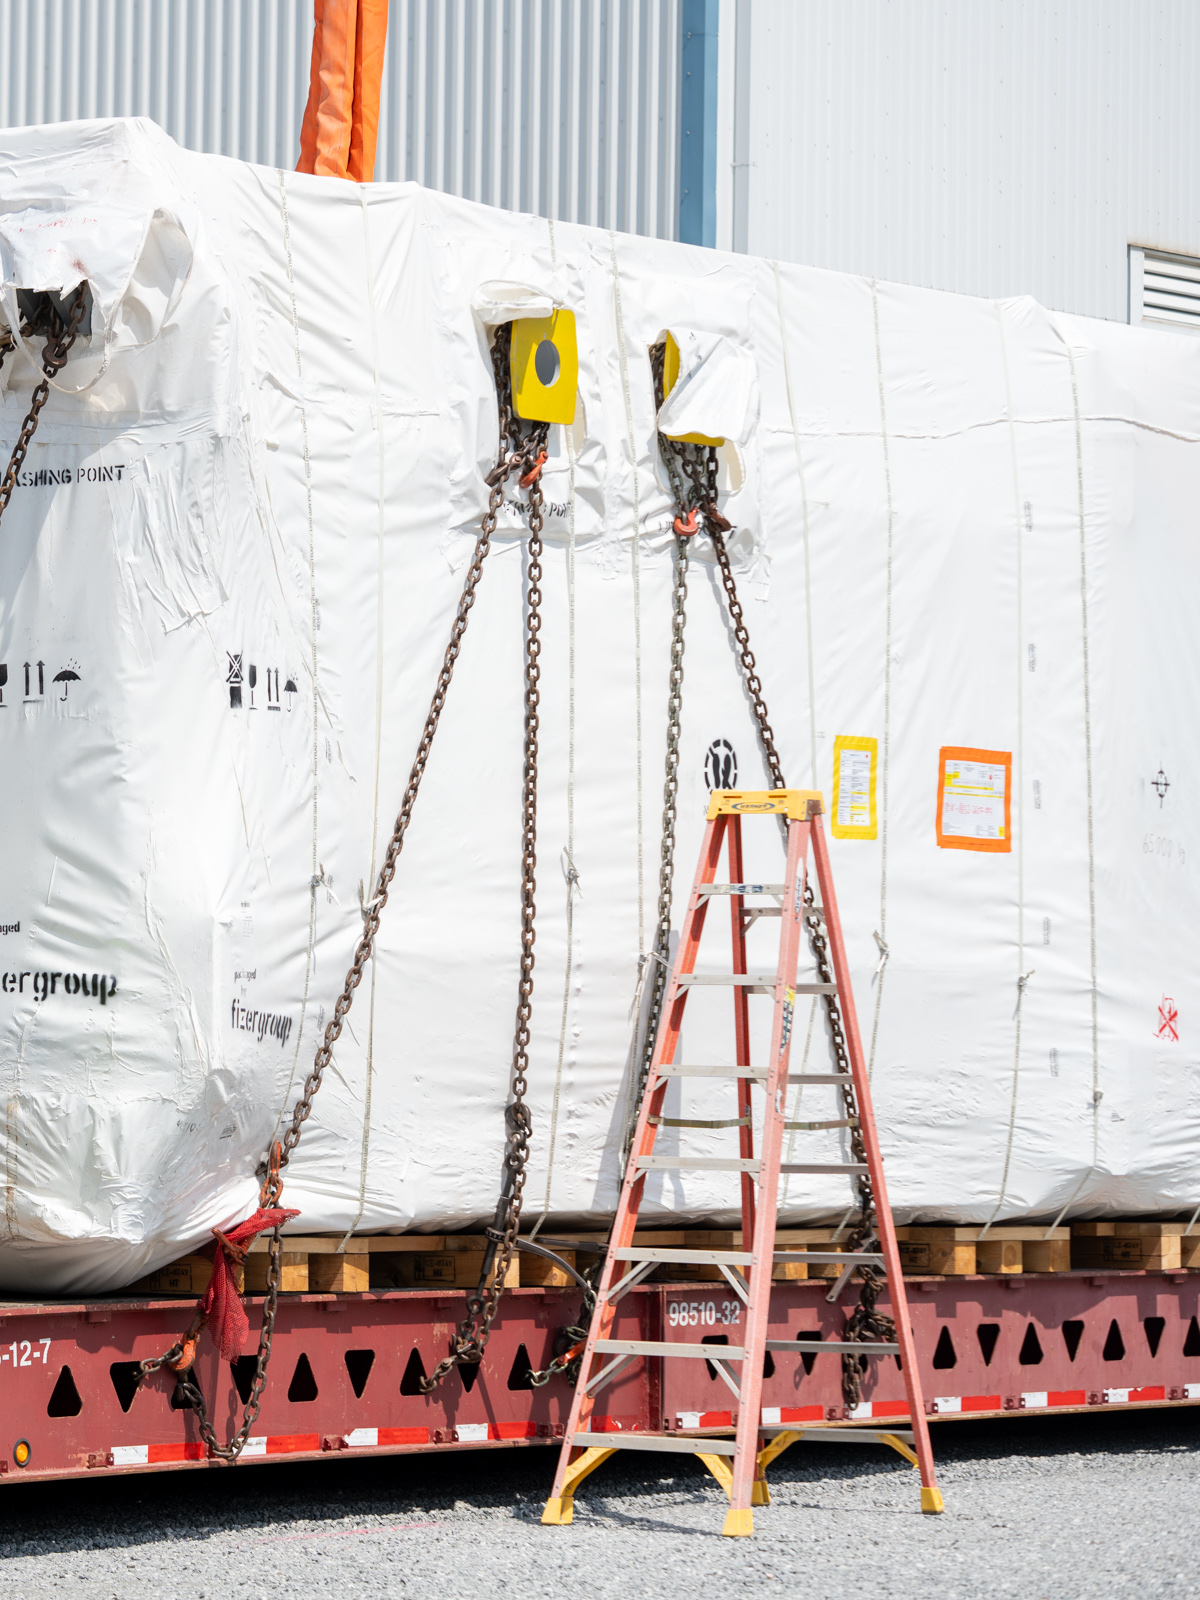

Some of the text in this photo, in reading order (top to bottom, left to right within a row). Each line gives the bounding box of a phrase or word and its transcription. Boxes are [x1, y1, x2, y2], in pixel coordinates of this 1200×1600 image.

[76, 464, 126, 484] POINT
[234, 968, 257, 983] packaged
[231, 998, 292, 1048] fizergroup
[668, 1300, 740, 1328] 98510-32
